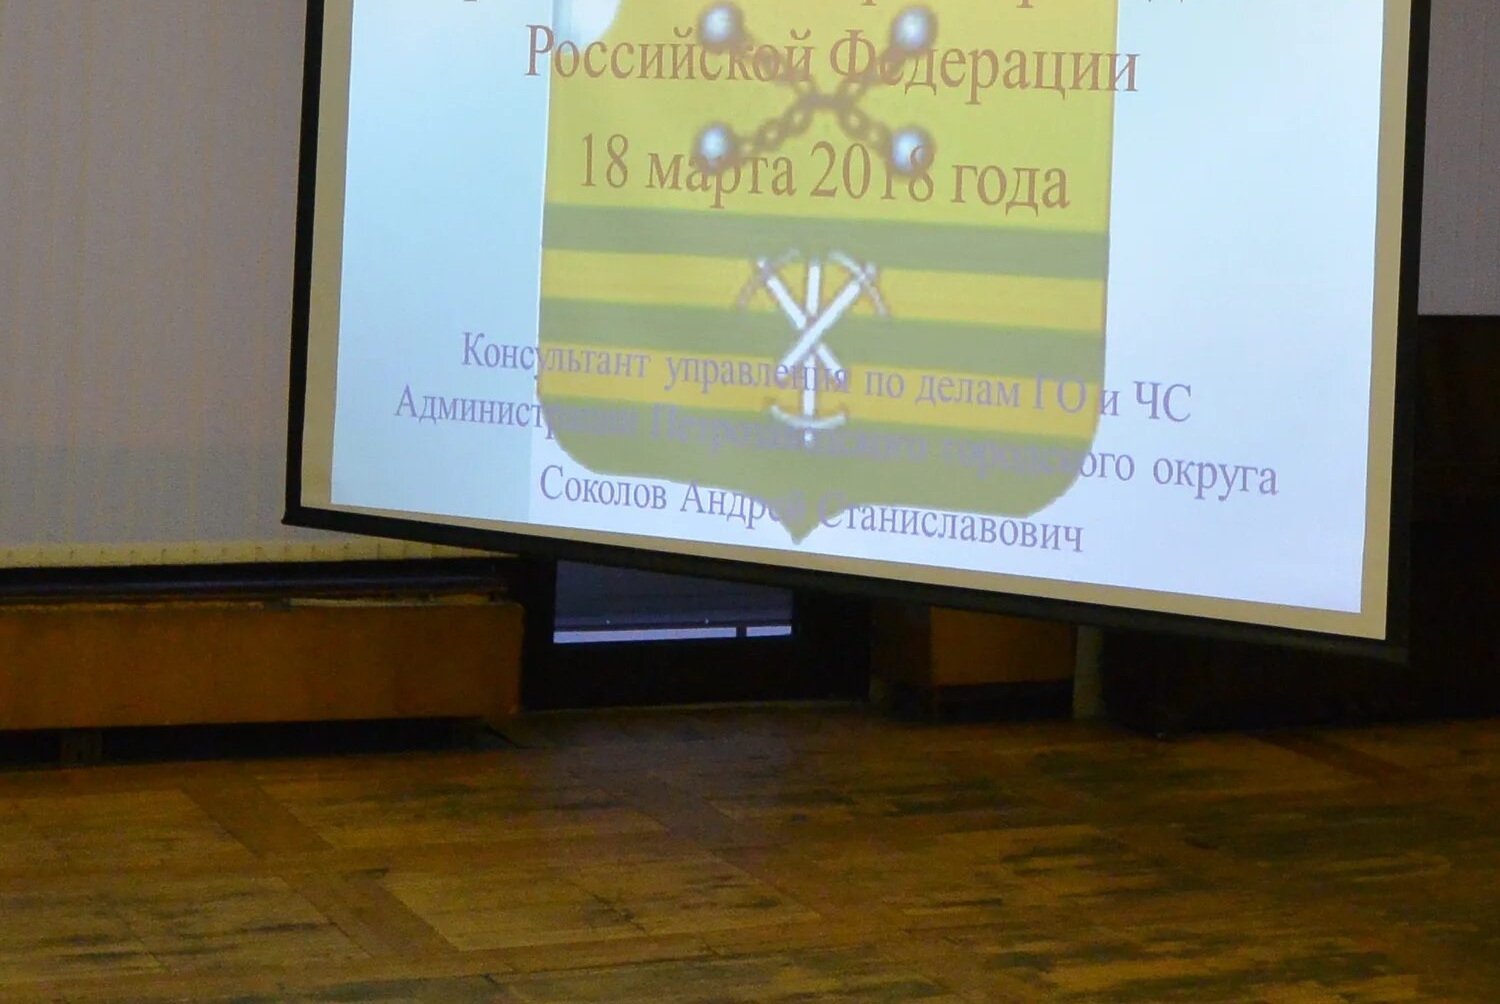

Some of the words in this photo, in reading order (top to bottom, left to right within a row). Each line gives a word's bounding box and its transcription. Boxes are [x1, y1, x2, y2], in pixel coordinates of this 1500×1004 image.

[525, 25, 814, 82] Российской
[829, 29, 1140, 104] Федерации
[581, 132, 629, 189] 18
[645, 149, 797, 209] марта
[809, 141, 935, 200] 2018
[951, 162, 1071, 217] года
[462, 331, 652, 380] Консультант
[664, 353, 850, 394] управления
[864, 369, 905, 398] по
[914, 372, 1020, 408] делам
[1034, 373, 1088, 413] ГО
[1101, 389, 1120, 416] и
[1134, 380, 1192, 423] ЧС
[395, 383, 637, 440] Администр
[1153, 455, 1279, 502] округа
[539, 464, 667, 511] Соколов
[818, 489, 1083, 553] Станиславович
